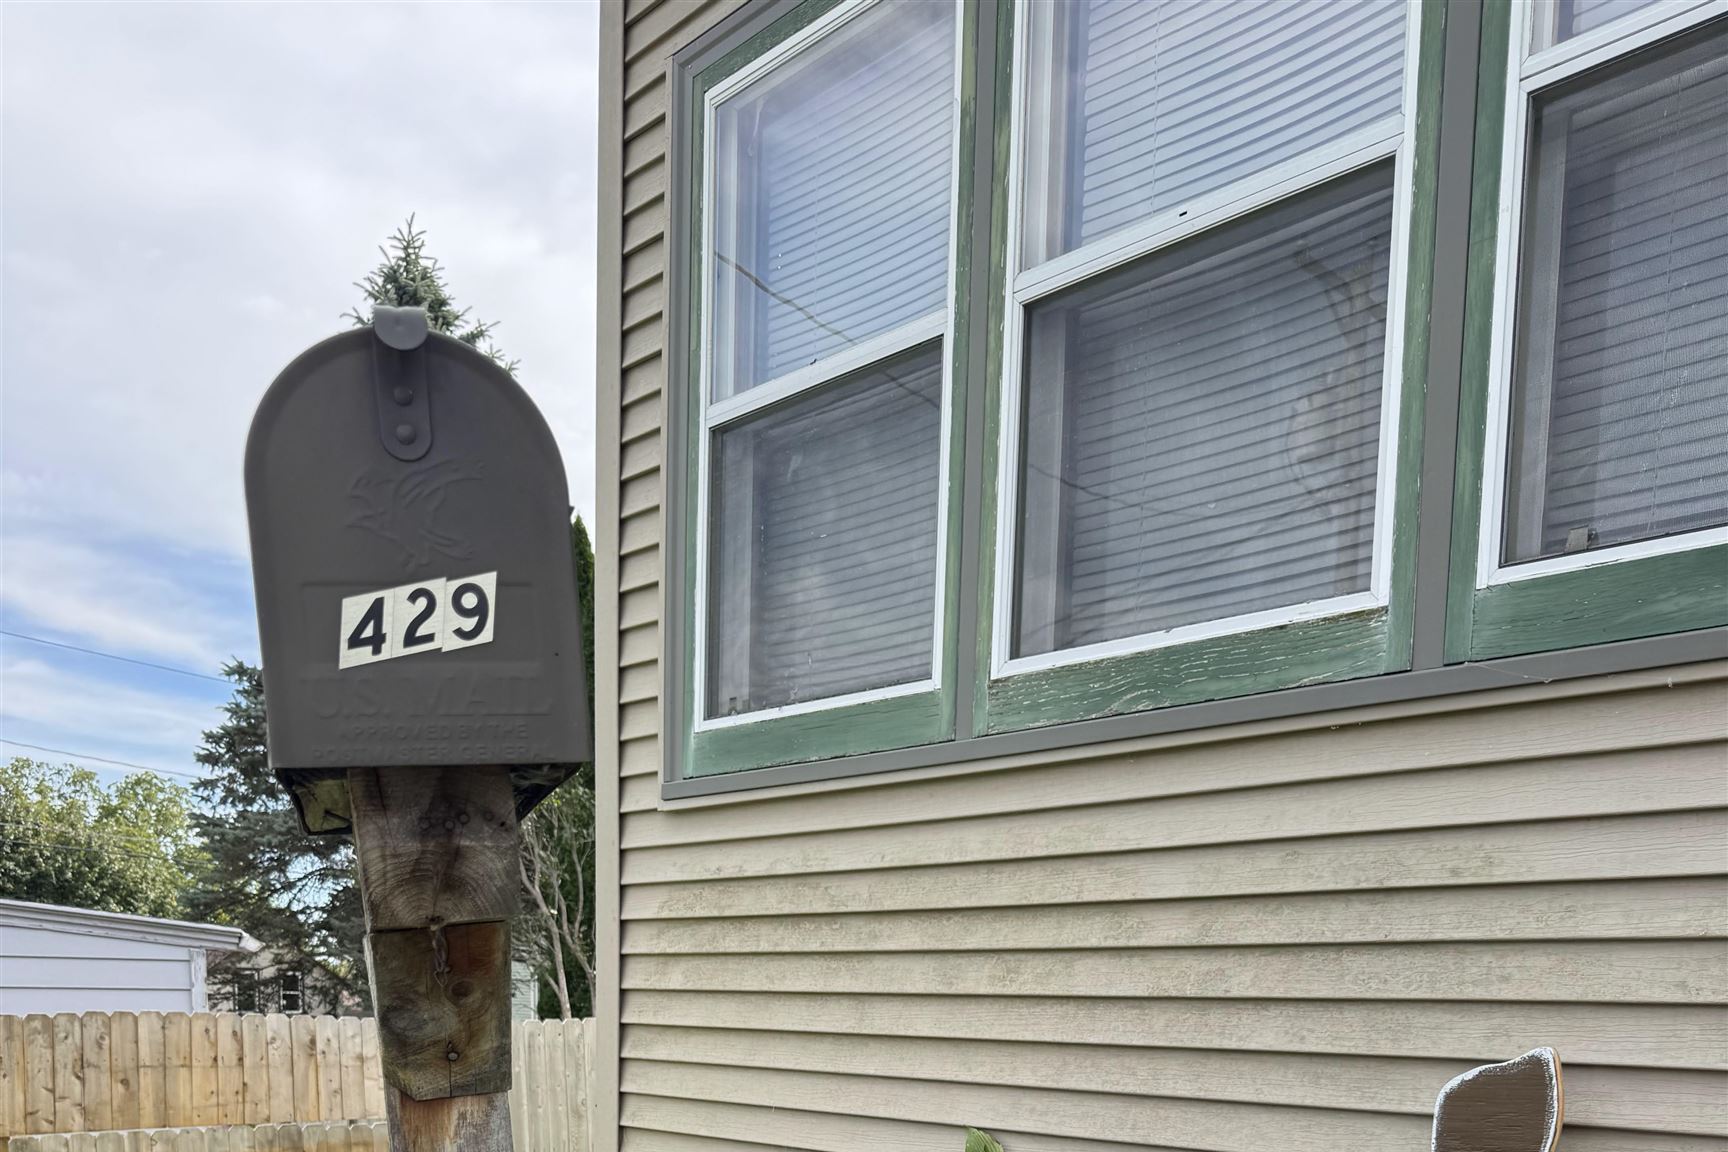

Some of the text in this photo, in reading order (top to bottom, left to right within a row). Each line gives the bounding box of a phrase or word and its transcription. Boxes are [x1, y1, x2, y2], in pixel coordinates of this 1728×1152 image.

[346, 582, 490, 656] 429
[403, 670, 552, 717] MAIL
[339, 720, 529, 741] APPROVED BY THE
